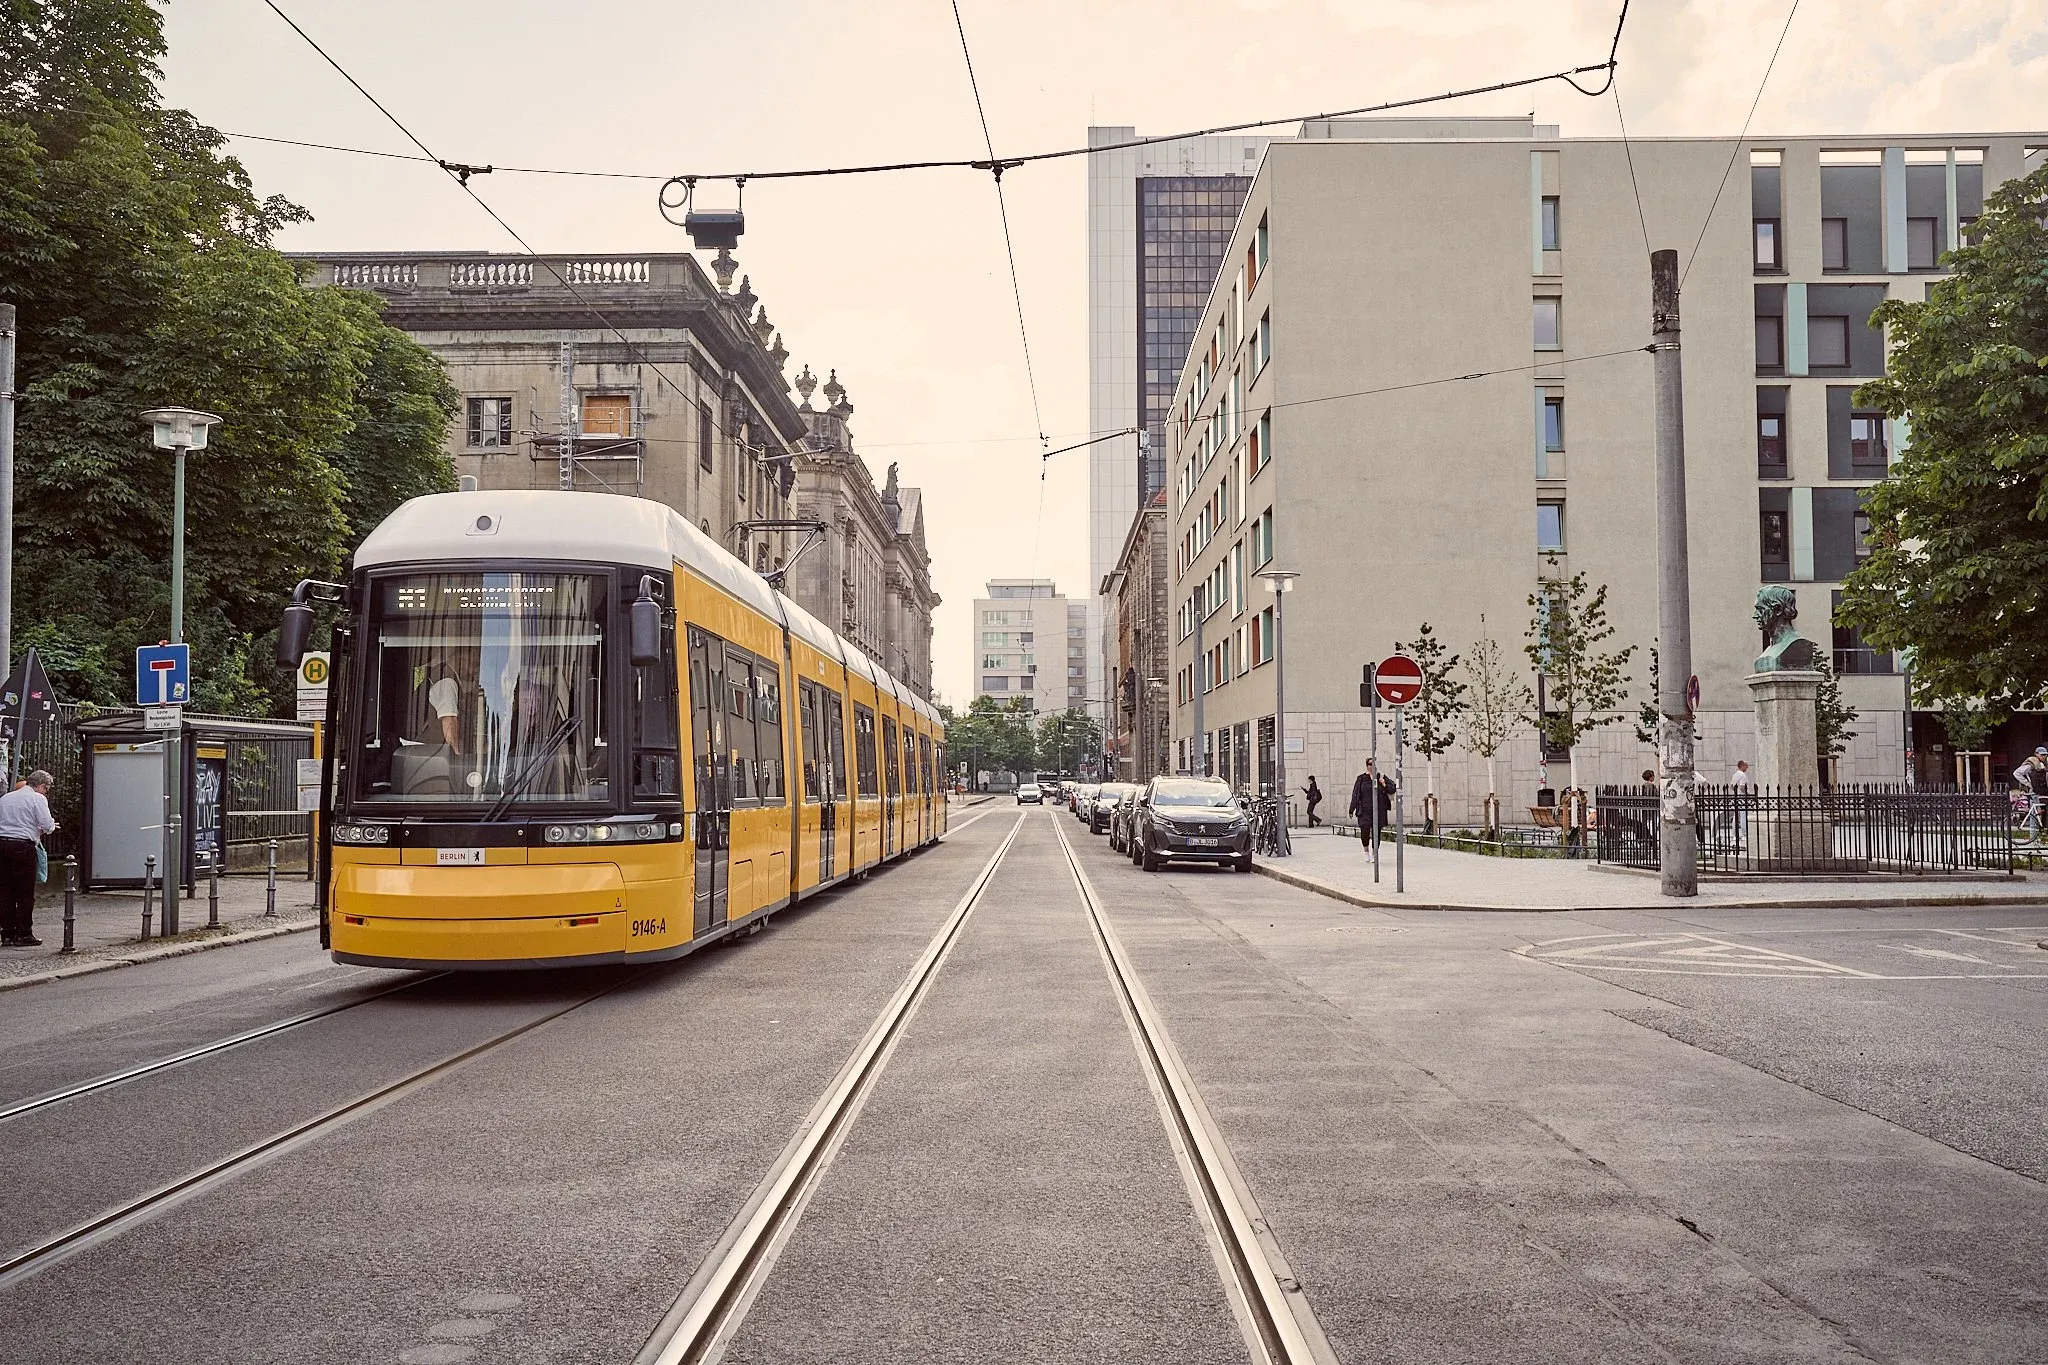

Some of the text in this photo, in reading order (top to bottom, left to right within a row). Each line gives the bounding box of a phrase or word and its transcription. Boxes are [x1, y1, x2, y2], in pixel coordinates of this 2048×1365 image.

[310, 664, 322, 678] H
[196, 804, 221, 830] LIVE
[632, 917, 667, 937] 9146-A
